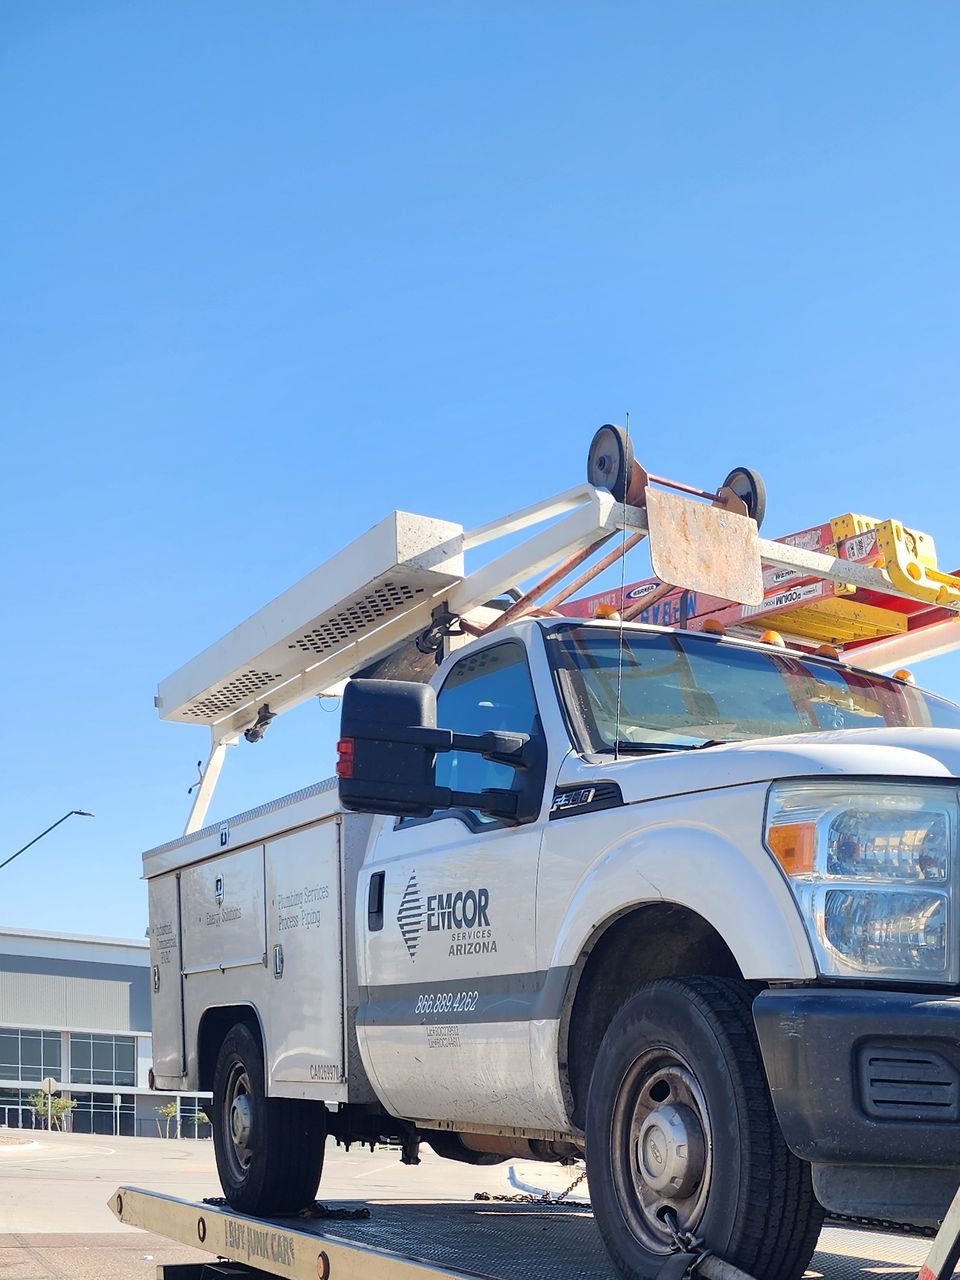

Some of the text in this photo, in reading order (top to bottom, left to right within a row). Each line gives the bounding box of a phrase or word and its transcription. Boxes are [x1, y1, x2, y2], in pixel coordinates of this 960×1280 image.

[776, 591, 802, 606] PODIUM
[304, 886, 328, 903] Services
[427, 888, 491, 932] EMCOR
[451, 929, 492, 942] SERVICES
[448, 940, 498, 957] ARIZONA
[415, 991, 479, 1014] 866.889.4262
[228, 1221, 245, 1250] BUY
[247, 1226, 269, 1260] JUNK
[271, 1233, 295, 1266] CARS
